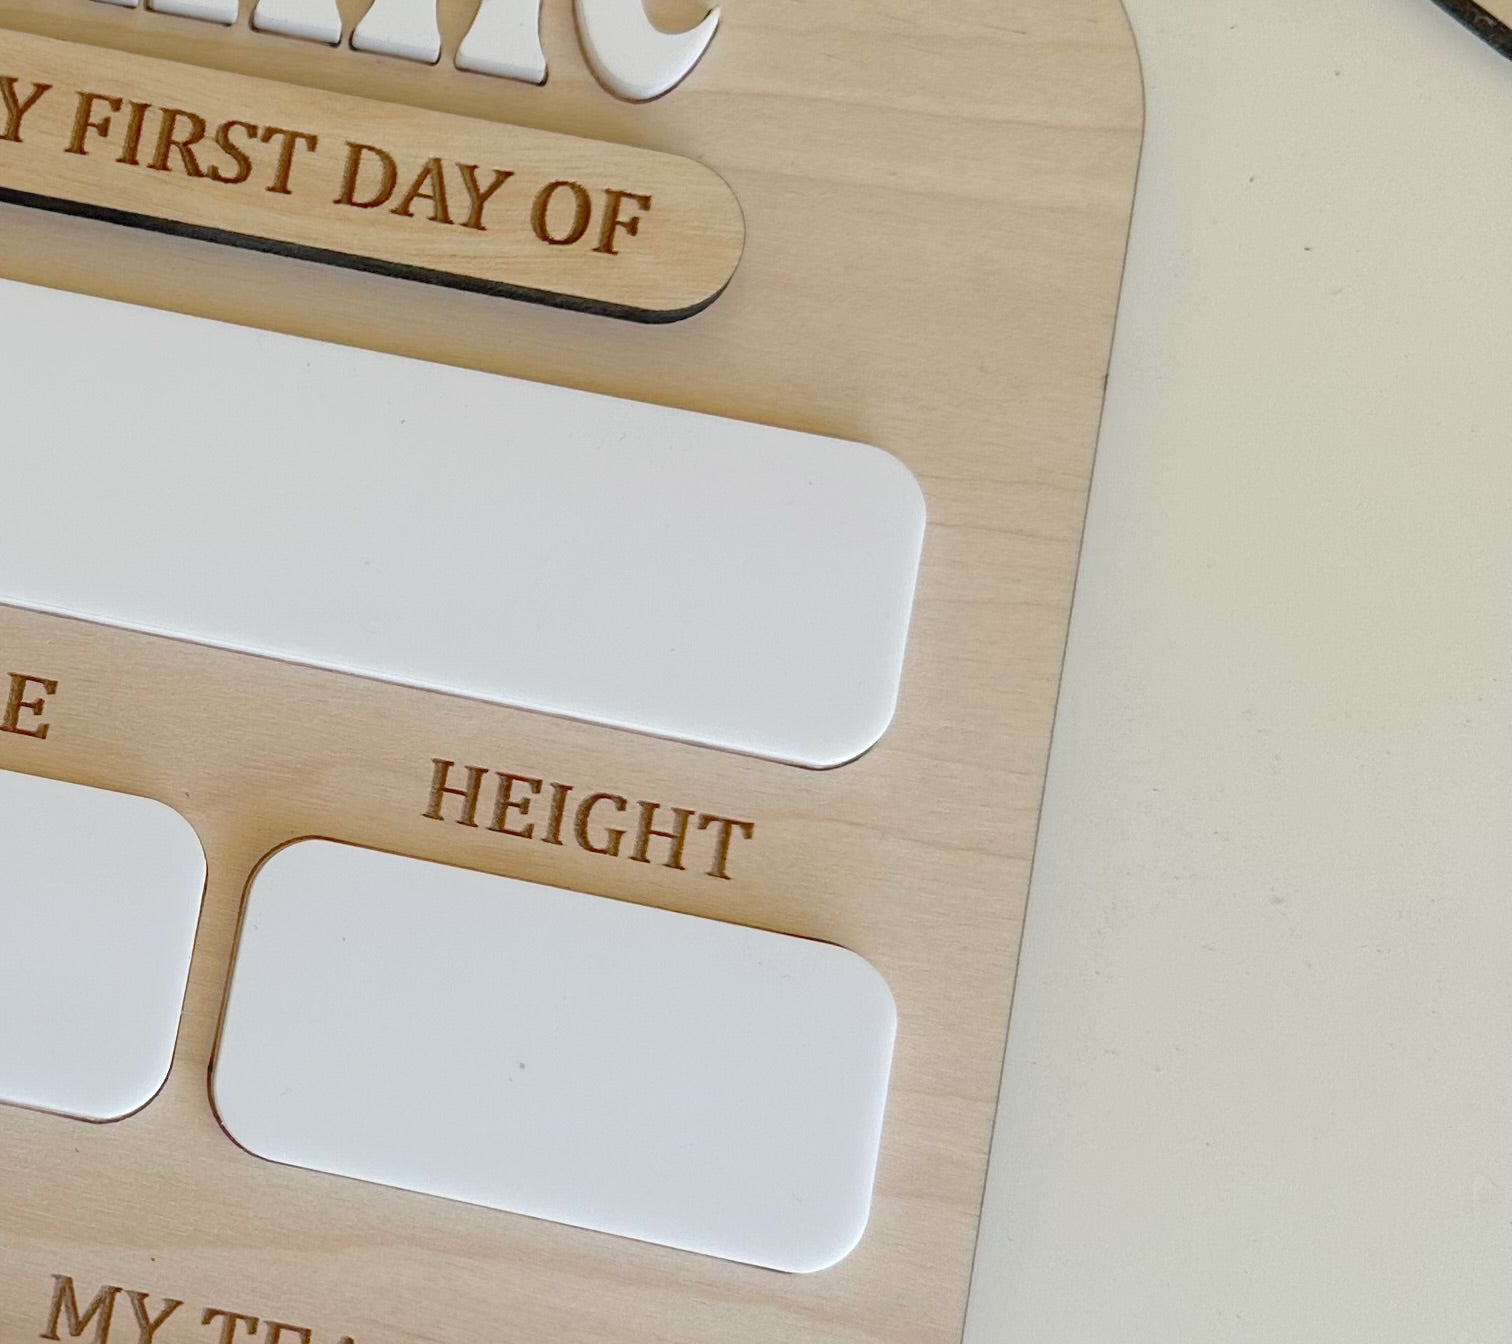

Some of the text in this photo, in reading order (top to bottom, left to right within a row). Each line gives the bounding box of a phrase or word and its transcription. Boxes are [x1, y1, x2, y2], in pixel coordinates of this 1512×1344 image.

[64, 92, 318, 196] FIRST
[333, 144, 514, 233] DAY
[530, 178, 651, 256] OF
[420, 758, 754, 883] HEIGHT
